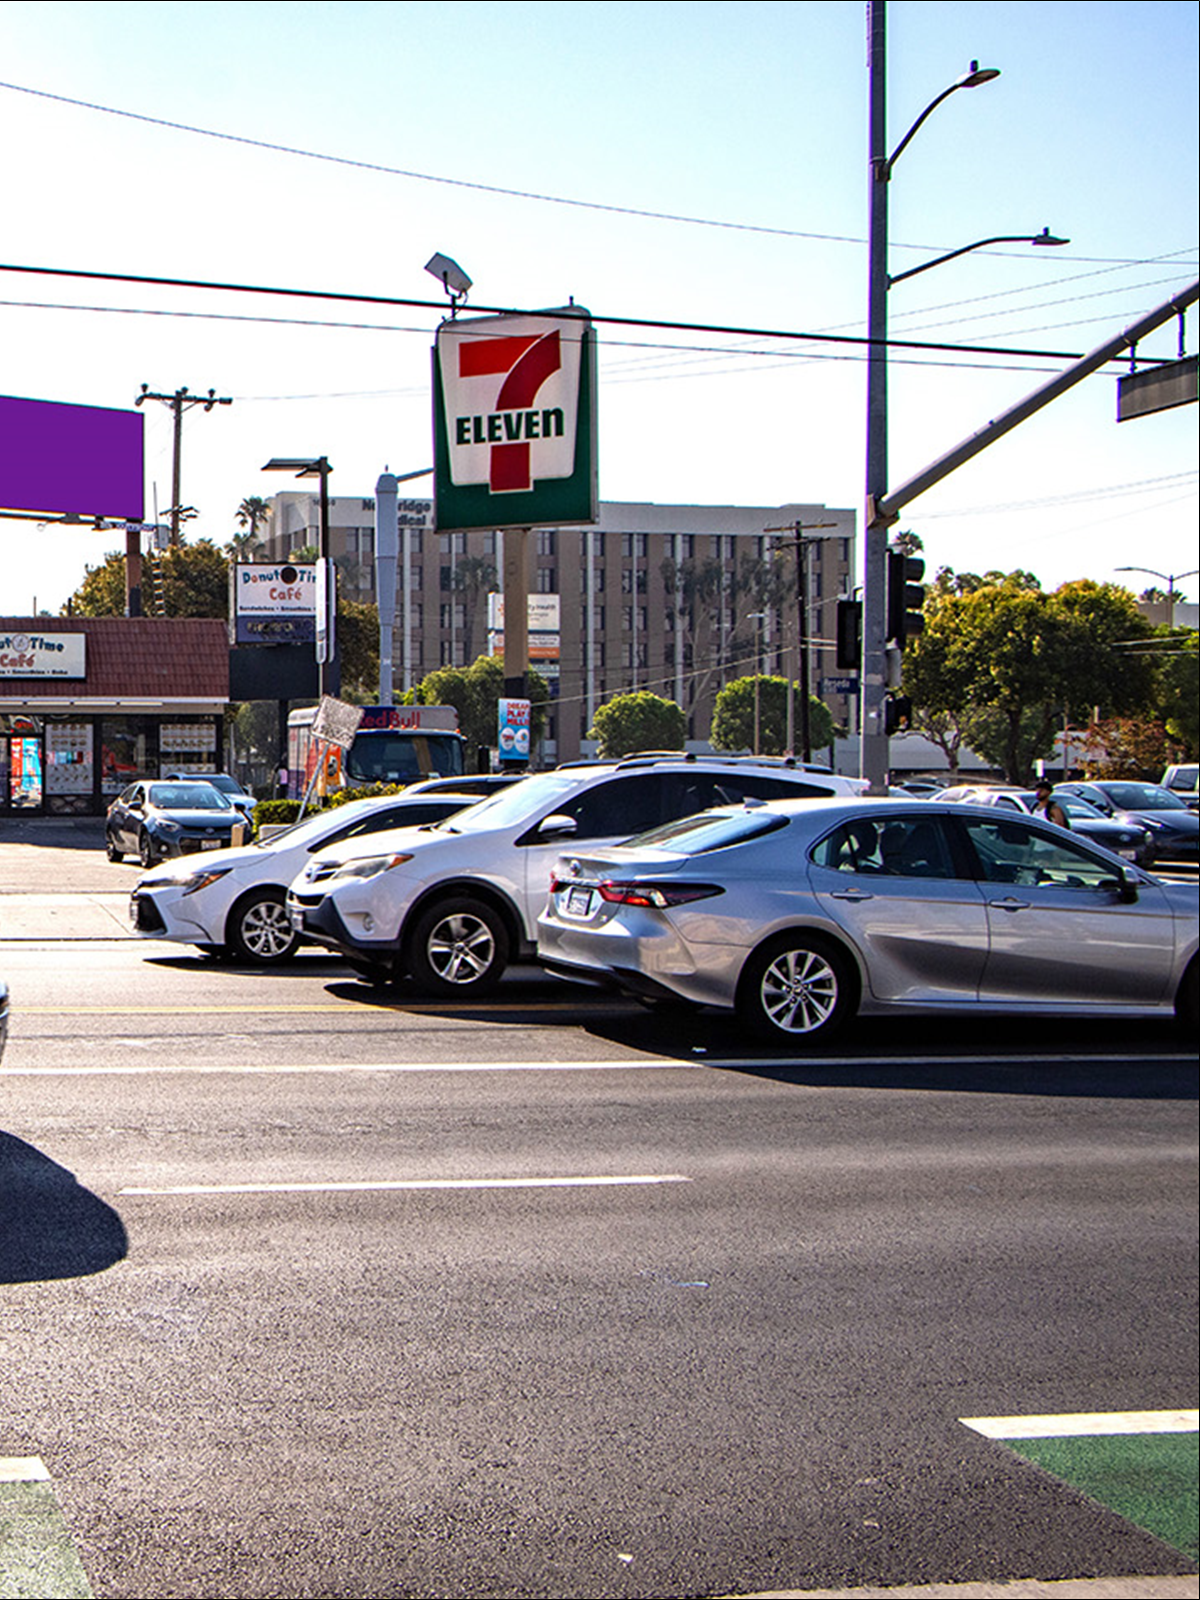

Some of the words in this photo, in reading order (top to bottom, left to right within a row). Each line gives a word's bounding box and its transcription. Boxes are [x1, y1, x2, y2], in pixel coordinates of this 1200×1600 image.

[459, 329, 561, 492] 7
[362, 499, 431, 514] Nridge
[398, 514, 426, 526] dical
[242, 569, 279, 584] Donut
[299, 570, 316, 583] Ti
[269, 587, 302, 600] Café
[30, 637, 65, 652] Time
[0, 653, 36, 668] Café
[360, 710, 387, 727] ed
[390, 710, 421, 727] Bull
